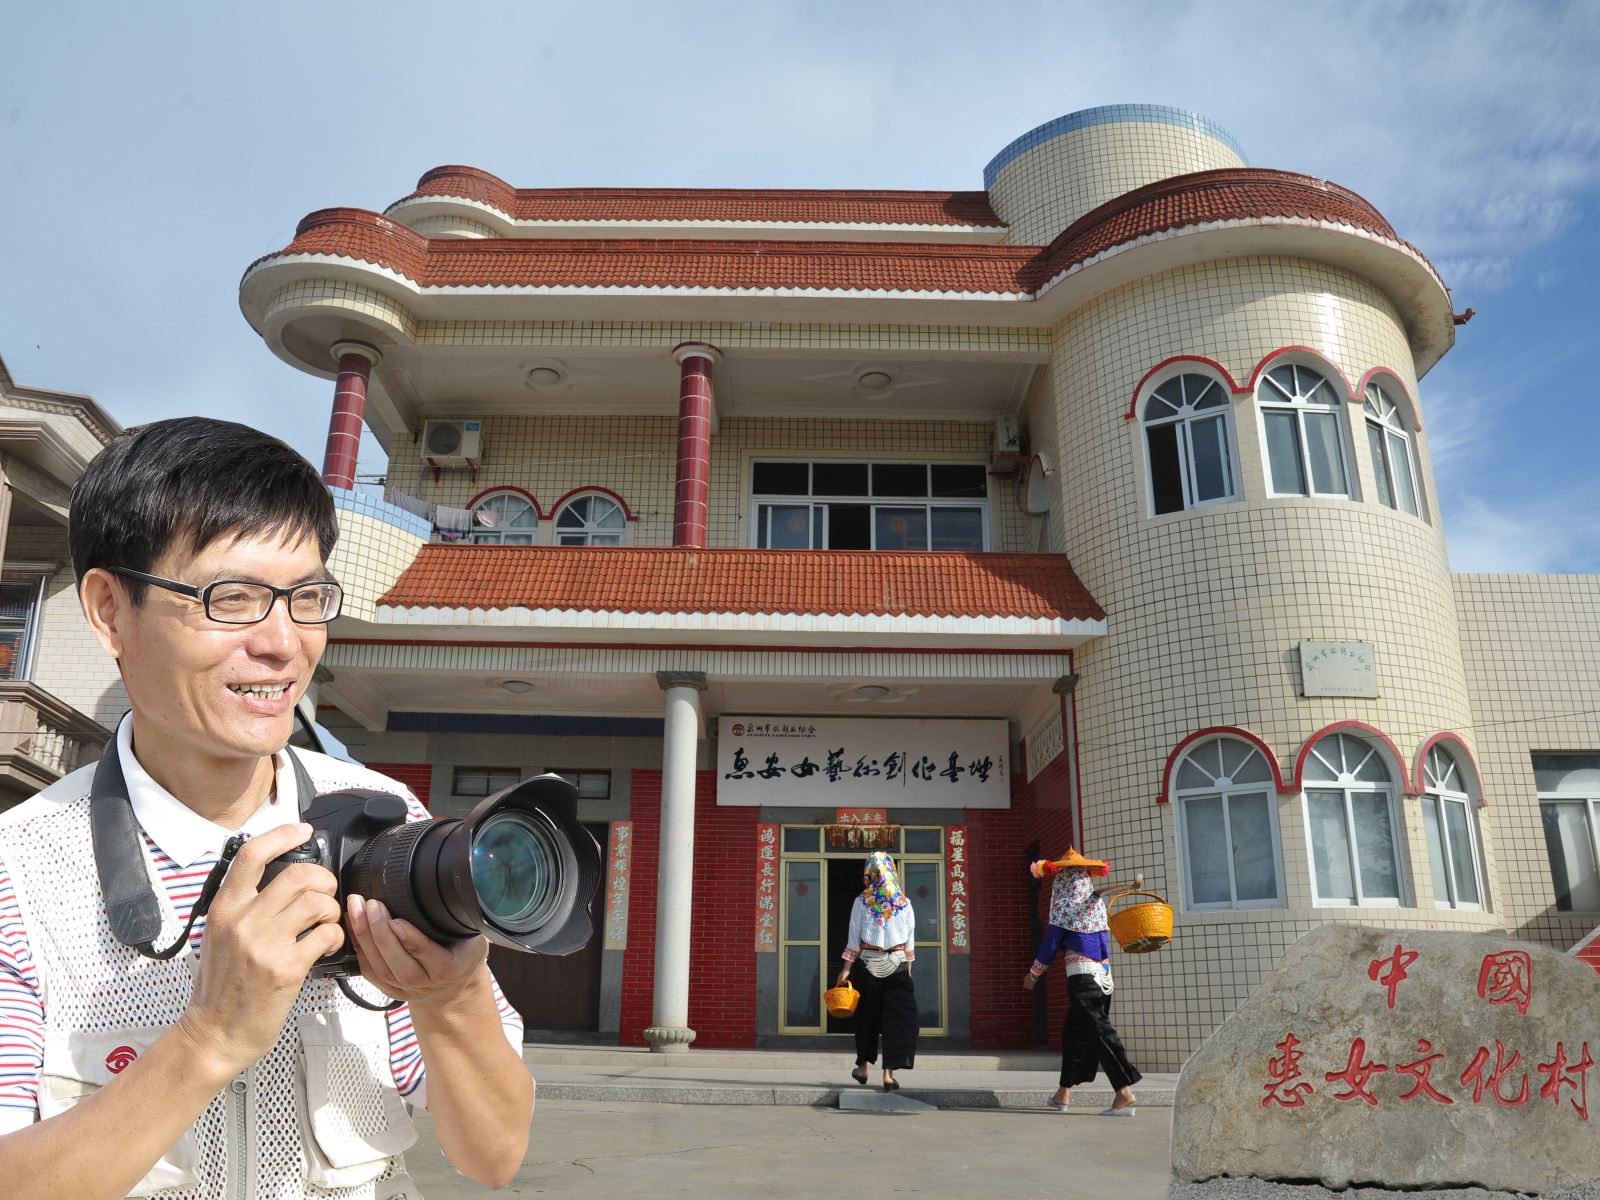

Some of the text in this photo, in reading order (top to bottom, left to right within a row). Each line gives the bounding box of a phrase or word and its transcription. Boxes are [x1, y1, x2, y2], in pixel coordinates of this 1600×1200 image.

[840, 812, 883, 823] 出入平安
[950, 830, 967, 947] 福星高照全家福
[1368, 944, 1532, 1015] 中國
[1262, 1032, 1595, 1121] 惠女文化村
